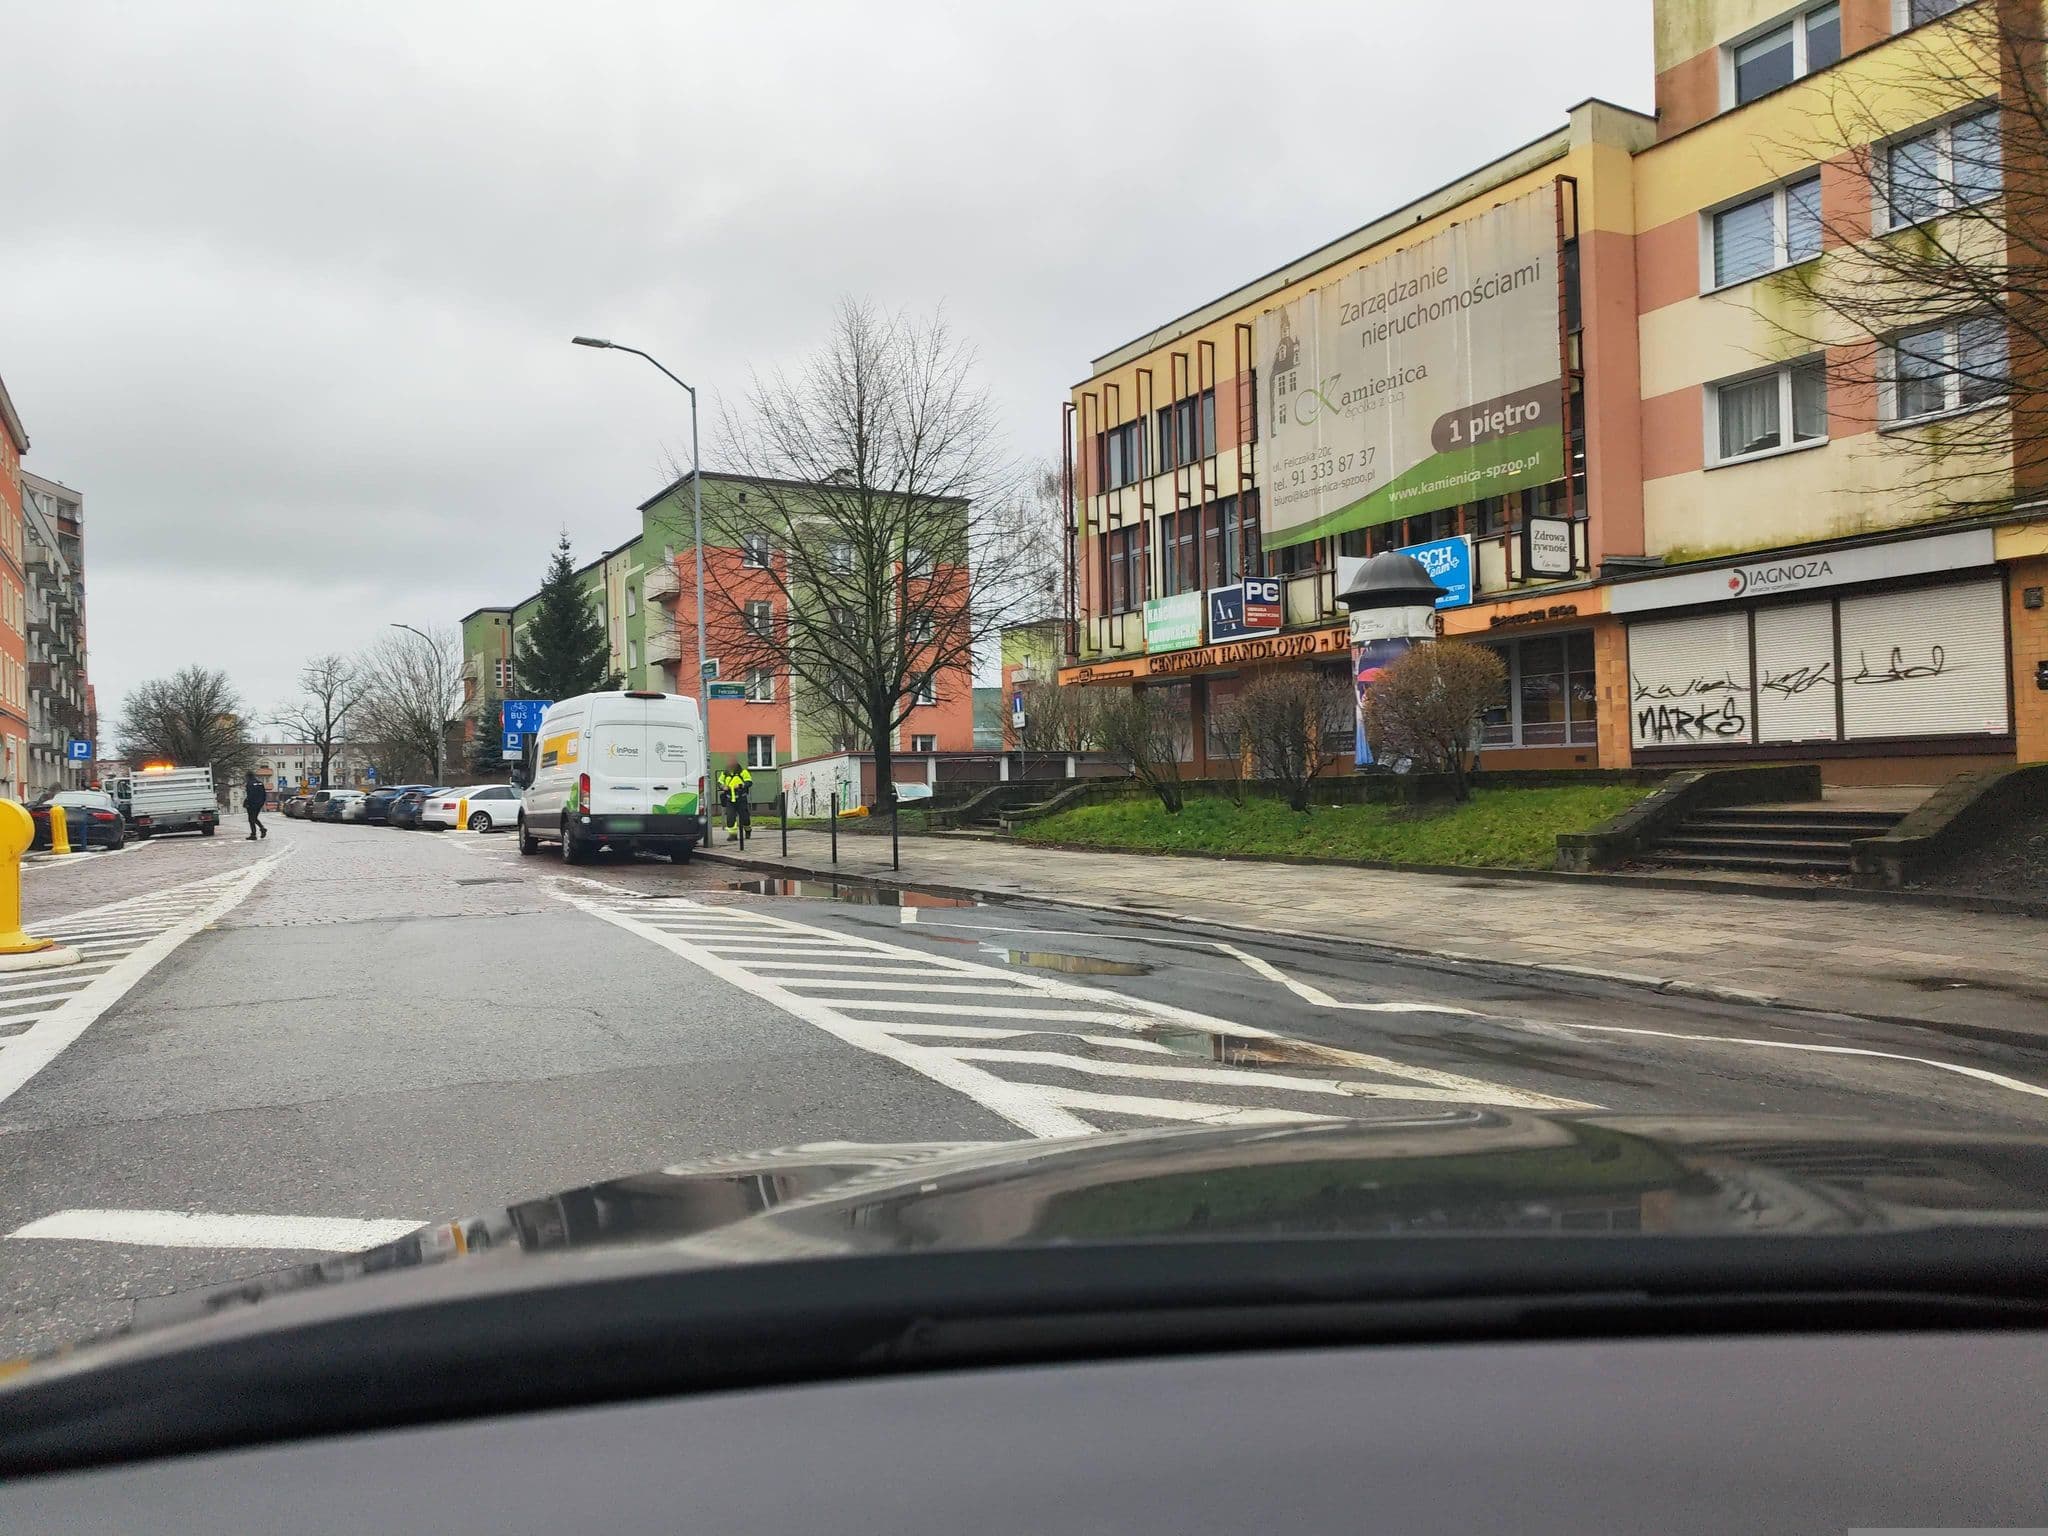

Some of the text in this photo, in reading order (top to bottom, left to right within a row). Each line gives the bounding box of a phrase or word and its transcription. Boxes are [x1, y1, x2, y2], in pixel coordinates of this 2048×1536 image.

[1340, 264, 1449, 327] Zarządzanie
[1361, 256, 1541, 348] nieruchomościami
[1449, 400, 1541, 443] 1 piętro
[1273, 446, 1375, 492] tel. 91 333 87 37
[1387, 451, 1541, 503] www.kamienica-spzoo.pl
[1533, 530, 1566, 542] Zdrowa
[1410, 546, 1452, 569] SCH
[1245, 582, 1279, 602] PC
[1149, 649, 1217, 674] CENTRUM
[1218, 634, 1317, 665] HANDLOWO
[510, 712, 527, 720] BUS
[616, 746, 639, 755] InPost
